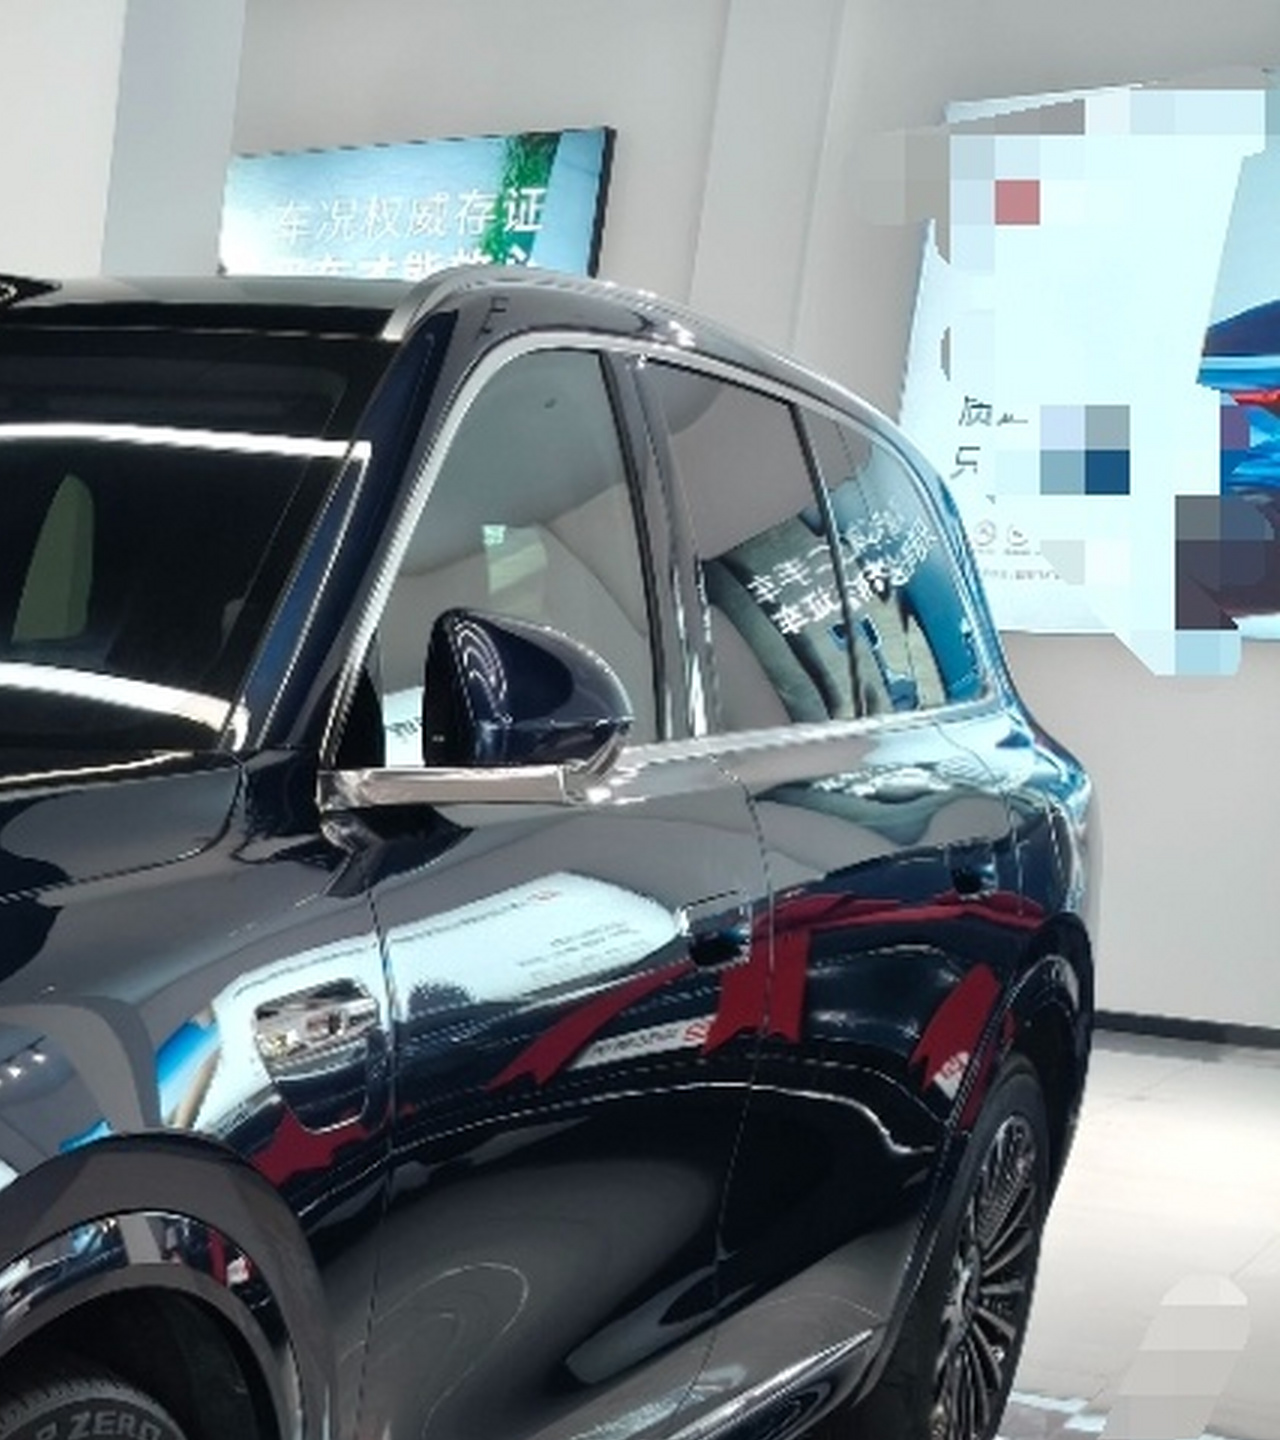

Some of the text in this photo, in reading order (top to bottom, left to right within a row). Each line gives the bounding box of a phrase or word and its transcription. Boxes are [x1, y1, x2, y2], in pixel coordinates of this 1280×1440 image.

[276, 187, 547, 246] 车况权威存证
